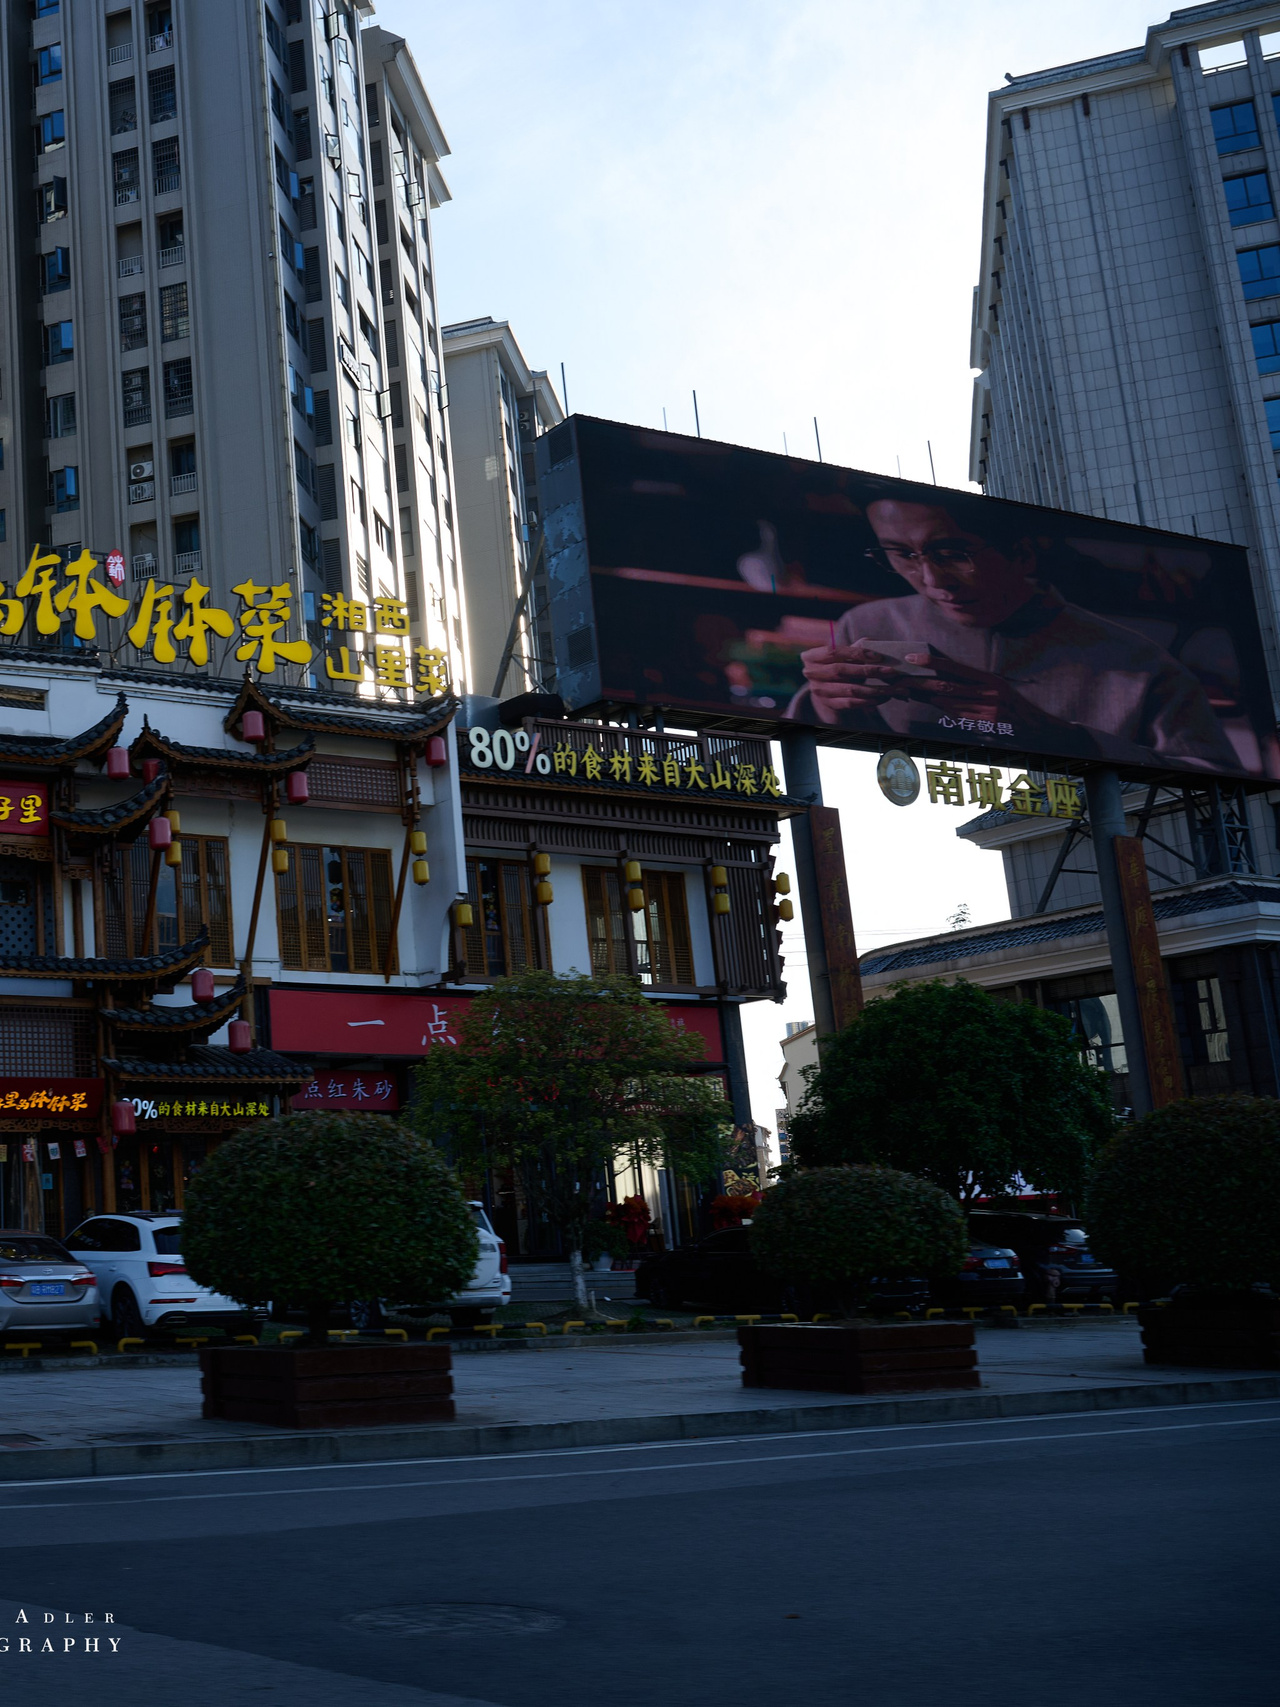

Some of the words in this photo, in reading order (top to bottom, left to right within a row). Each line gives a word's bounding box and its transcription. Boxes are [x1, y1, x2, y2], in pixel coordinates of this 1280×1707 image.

[321, 592, 410, 637] 湘西
[325, 643, 449, 696] 山里菜
[937, 714, 1016, 738] 心存敬畏
[468, 726, 784, 798] 80%的食材来自大山深处
[924, 761, 1083, 821] 南城金座
[122, 1096, 270, 1120] 0%的食材来自大山深处
